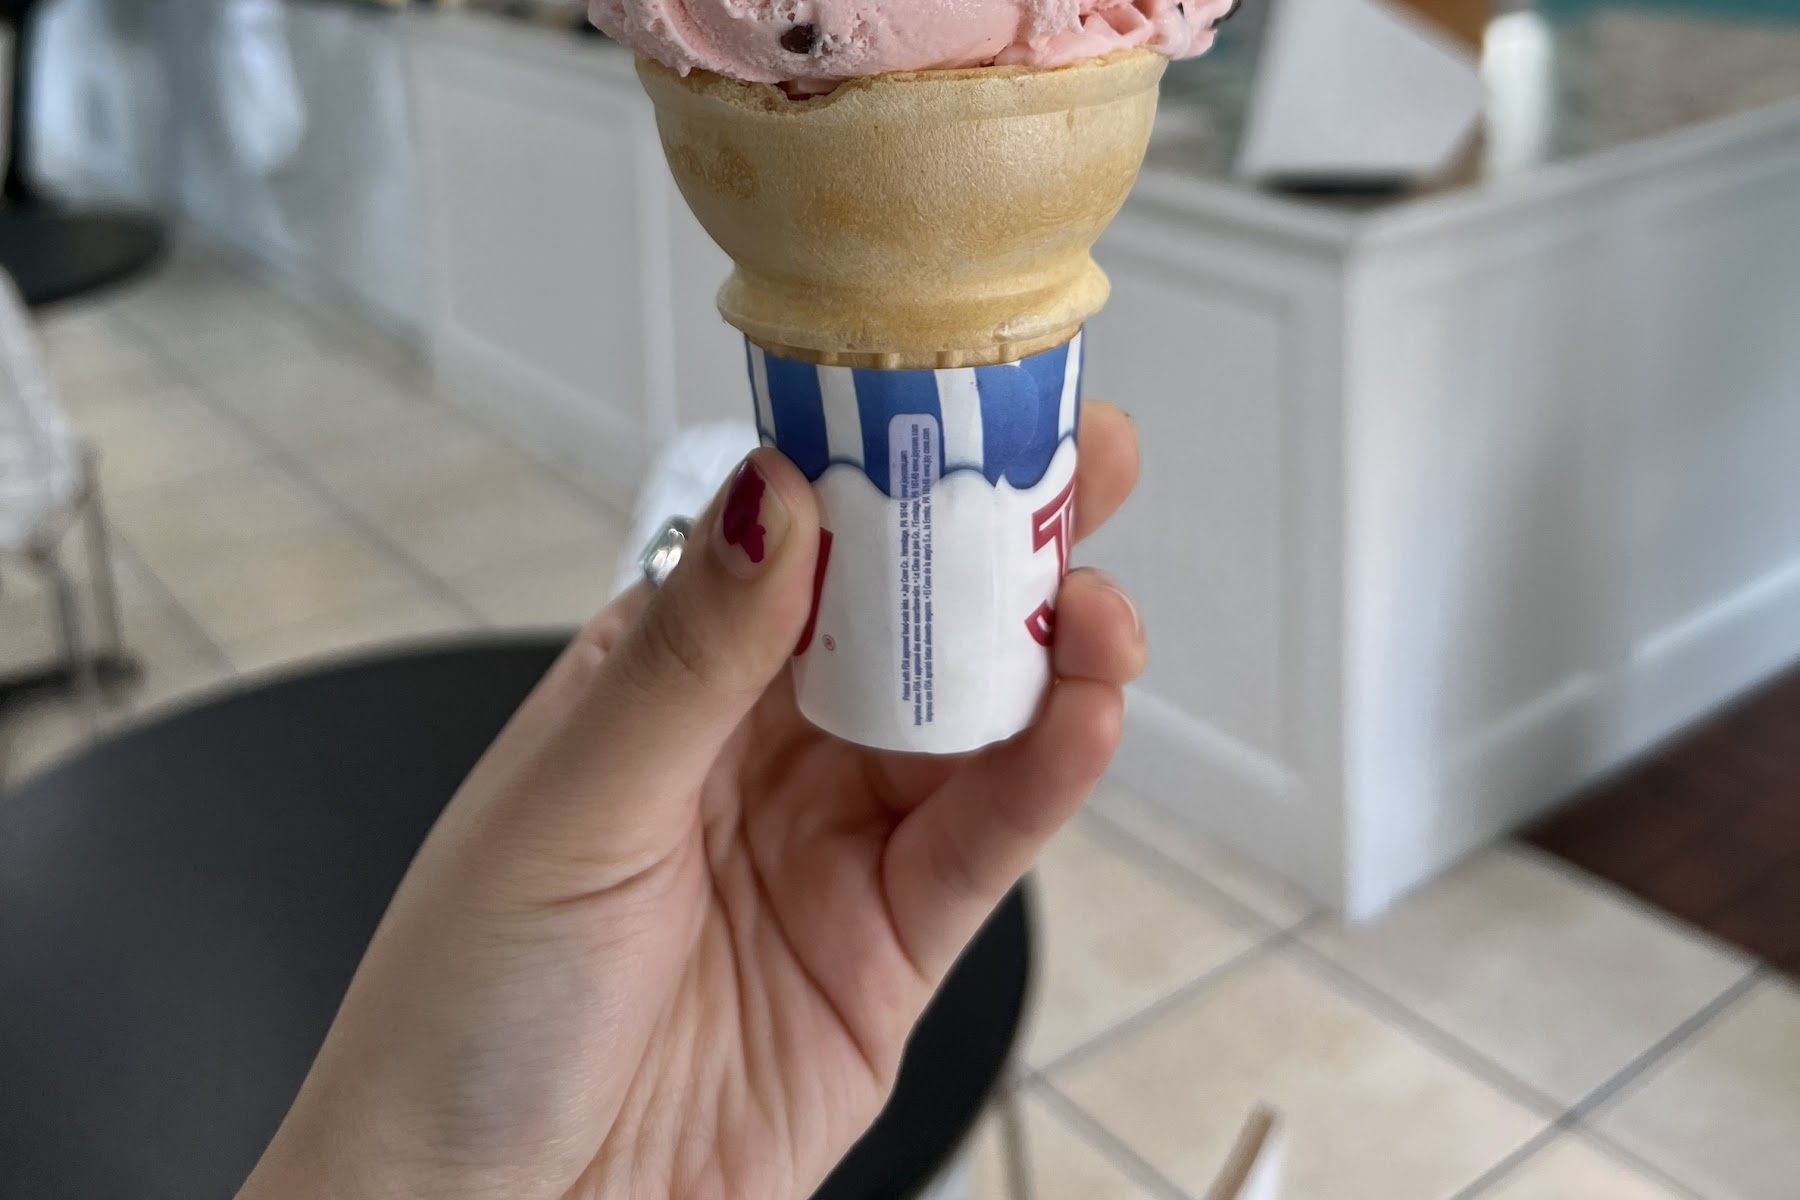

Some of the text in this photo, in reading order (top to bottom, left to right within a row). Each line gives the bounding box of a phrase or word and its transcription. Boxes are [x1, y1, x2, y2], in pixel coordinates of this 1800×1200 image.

[911, 473, 919, 489] 16148
[922, 478, 931, 495] 16148
[900, 502, 908, 519] 16148
[901, 569, 909, 583] Cone
[901, 584, 910, 594] Joy
[902, 660, 910, 670] FDA
[913, 681, 921, 692] FDA
[924, 680, 932, 691] FDA
